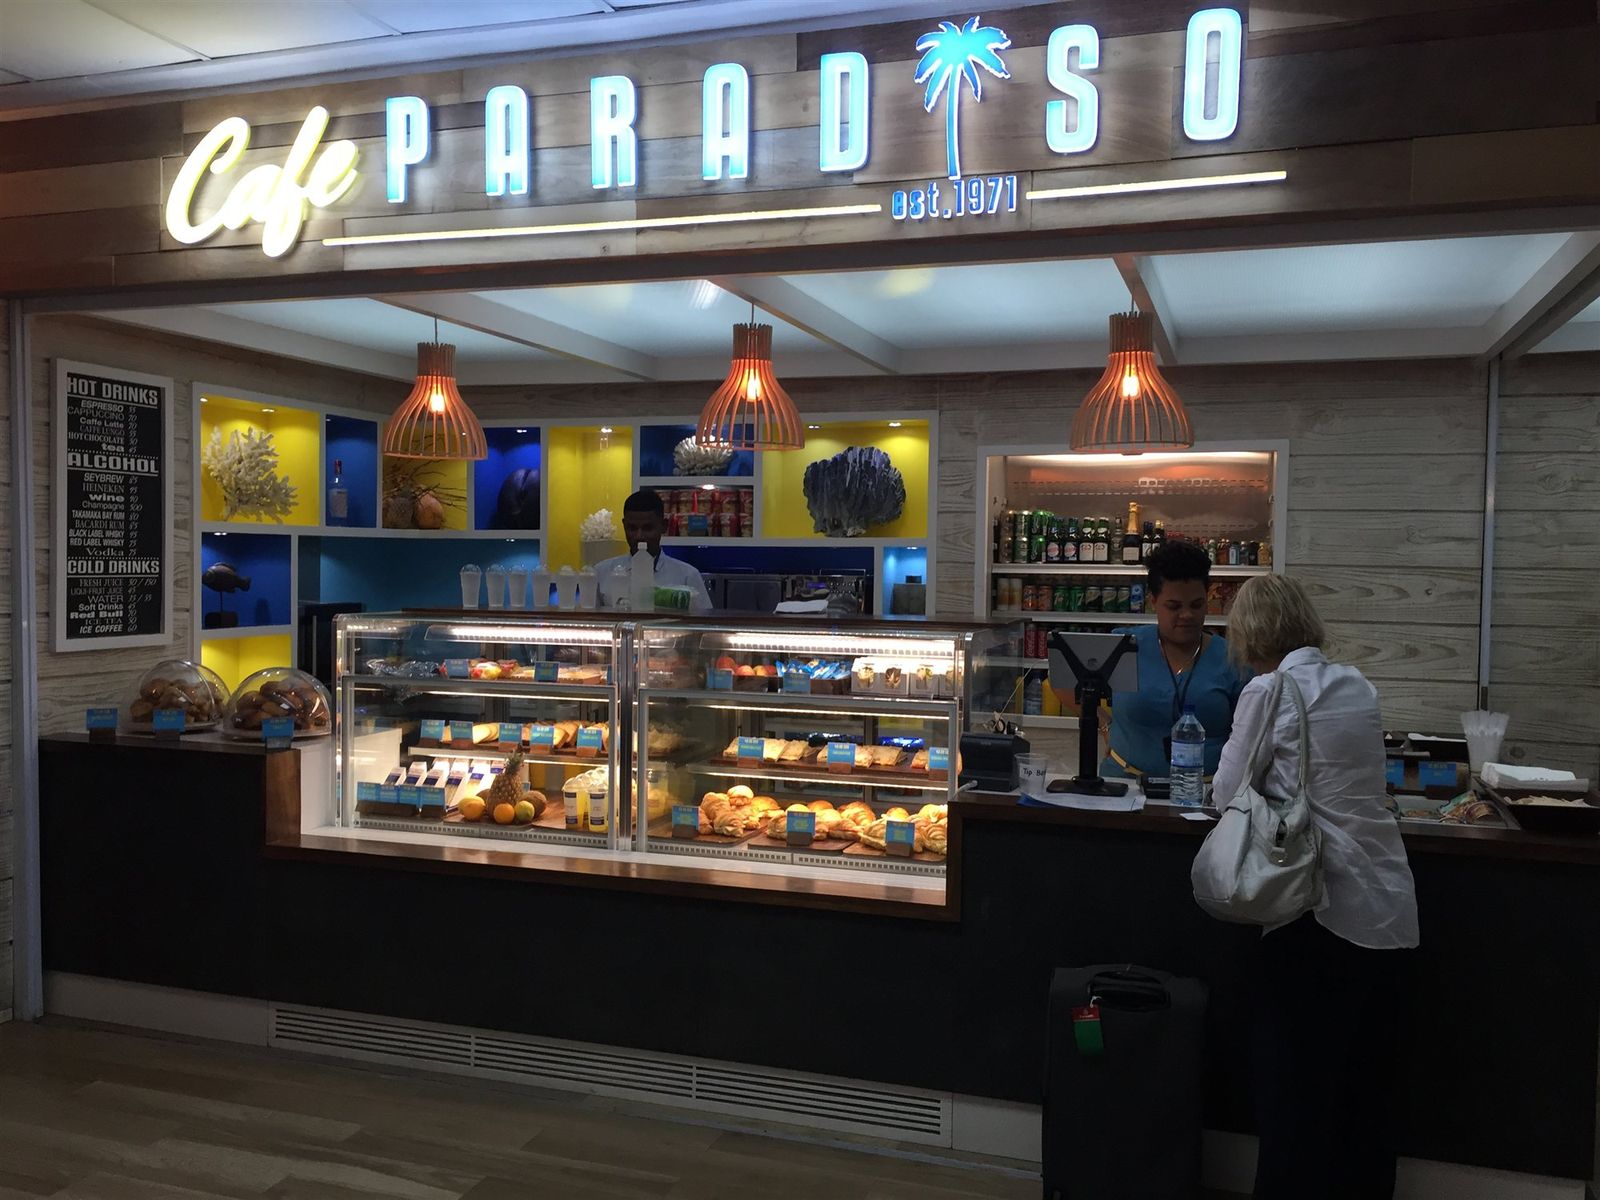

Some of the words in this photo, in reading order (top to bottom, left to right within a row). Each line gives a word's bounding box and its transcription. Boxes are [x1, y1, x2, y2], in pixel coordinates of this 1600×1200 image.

[165, 106, 359, 258] Cafe
[892, 174, 1018, 221] est.1971
[67, 376, 97, 396] HOT
[102, 382, 158, 405] DRINKS
[81, 400, 124, 413] ESPRESSO
[67, 406, 125, 421] CAPPUCCINO
[104, 420, 124, 428] Latte
[101, 443, 124, 452] tea
[67, 452, 159, 473] ALCOHOL
[84, 473, 124, 483] SEYBREW
[82, 482, 124, 493] HEINEKEN
[89, 493, 125, 502] wine
[82, 501, 124, 511] Champagne
[75, 519, 108, 529] BACARDI
[68, 529, 87, 537] BLACK
[88, 530, 104, 538] LABEL
[70, 538, 82, 546] RED
[83, 538, 101, 546] LABEL
[86, 548, 124, 556] Vodka
[68, 560, 104, 574] COLD
[109, 560, 160, 574] DRINKS
[80, 579, 102, 587] FRESH
[87, 595, 123, 603] WATER
[79, 603, 95, 611] Soft
[98, 603, 123, 611] Drinks
[70, 611, 95, 619] Red
[99, 610, 123, 618] Bull
[80, 625, 92, 634] ICE
[95, 624, 123, 633] COFFEE
